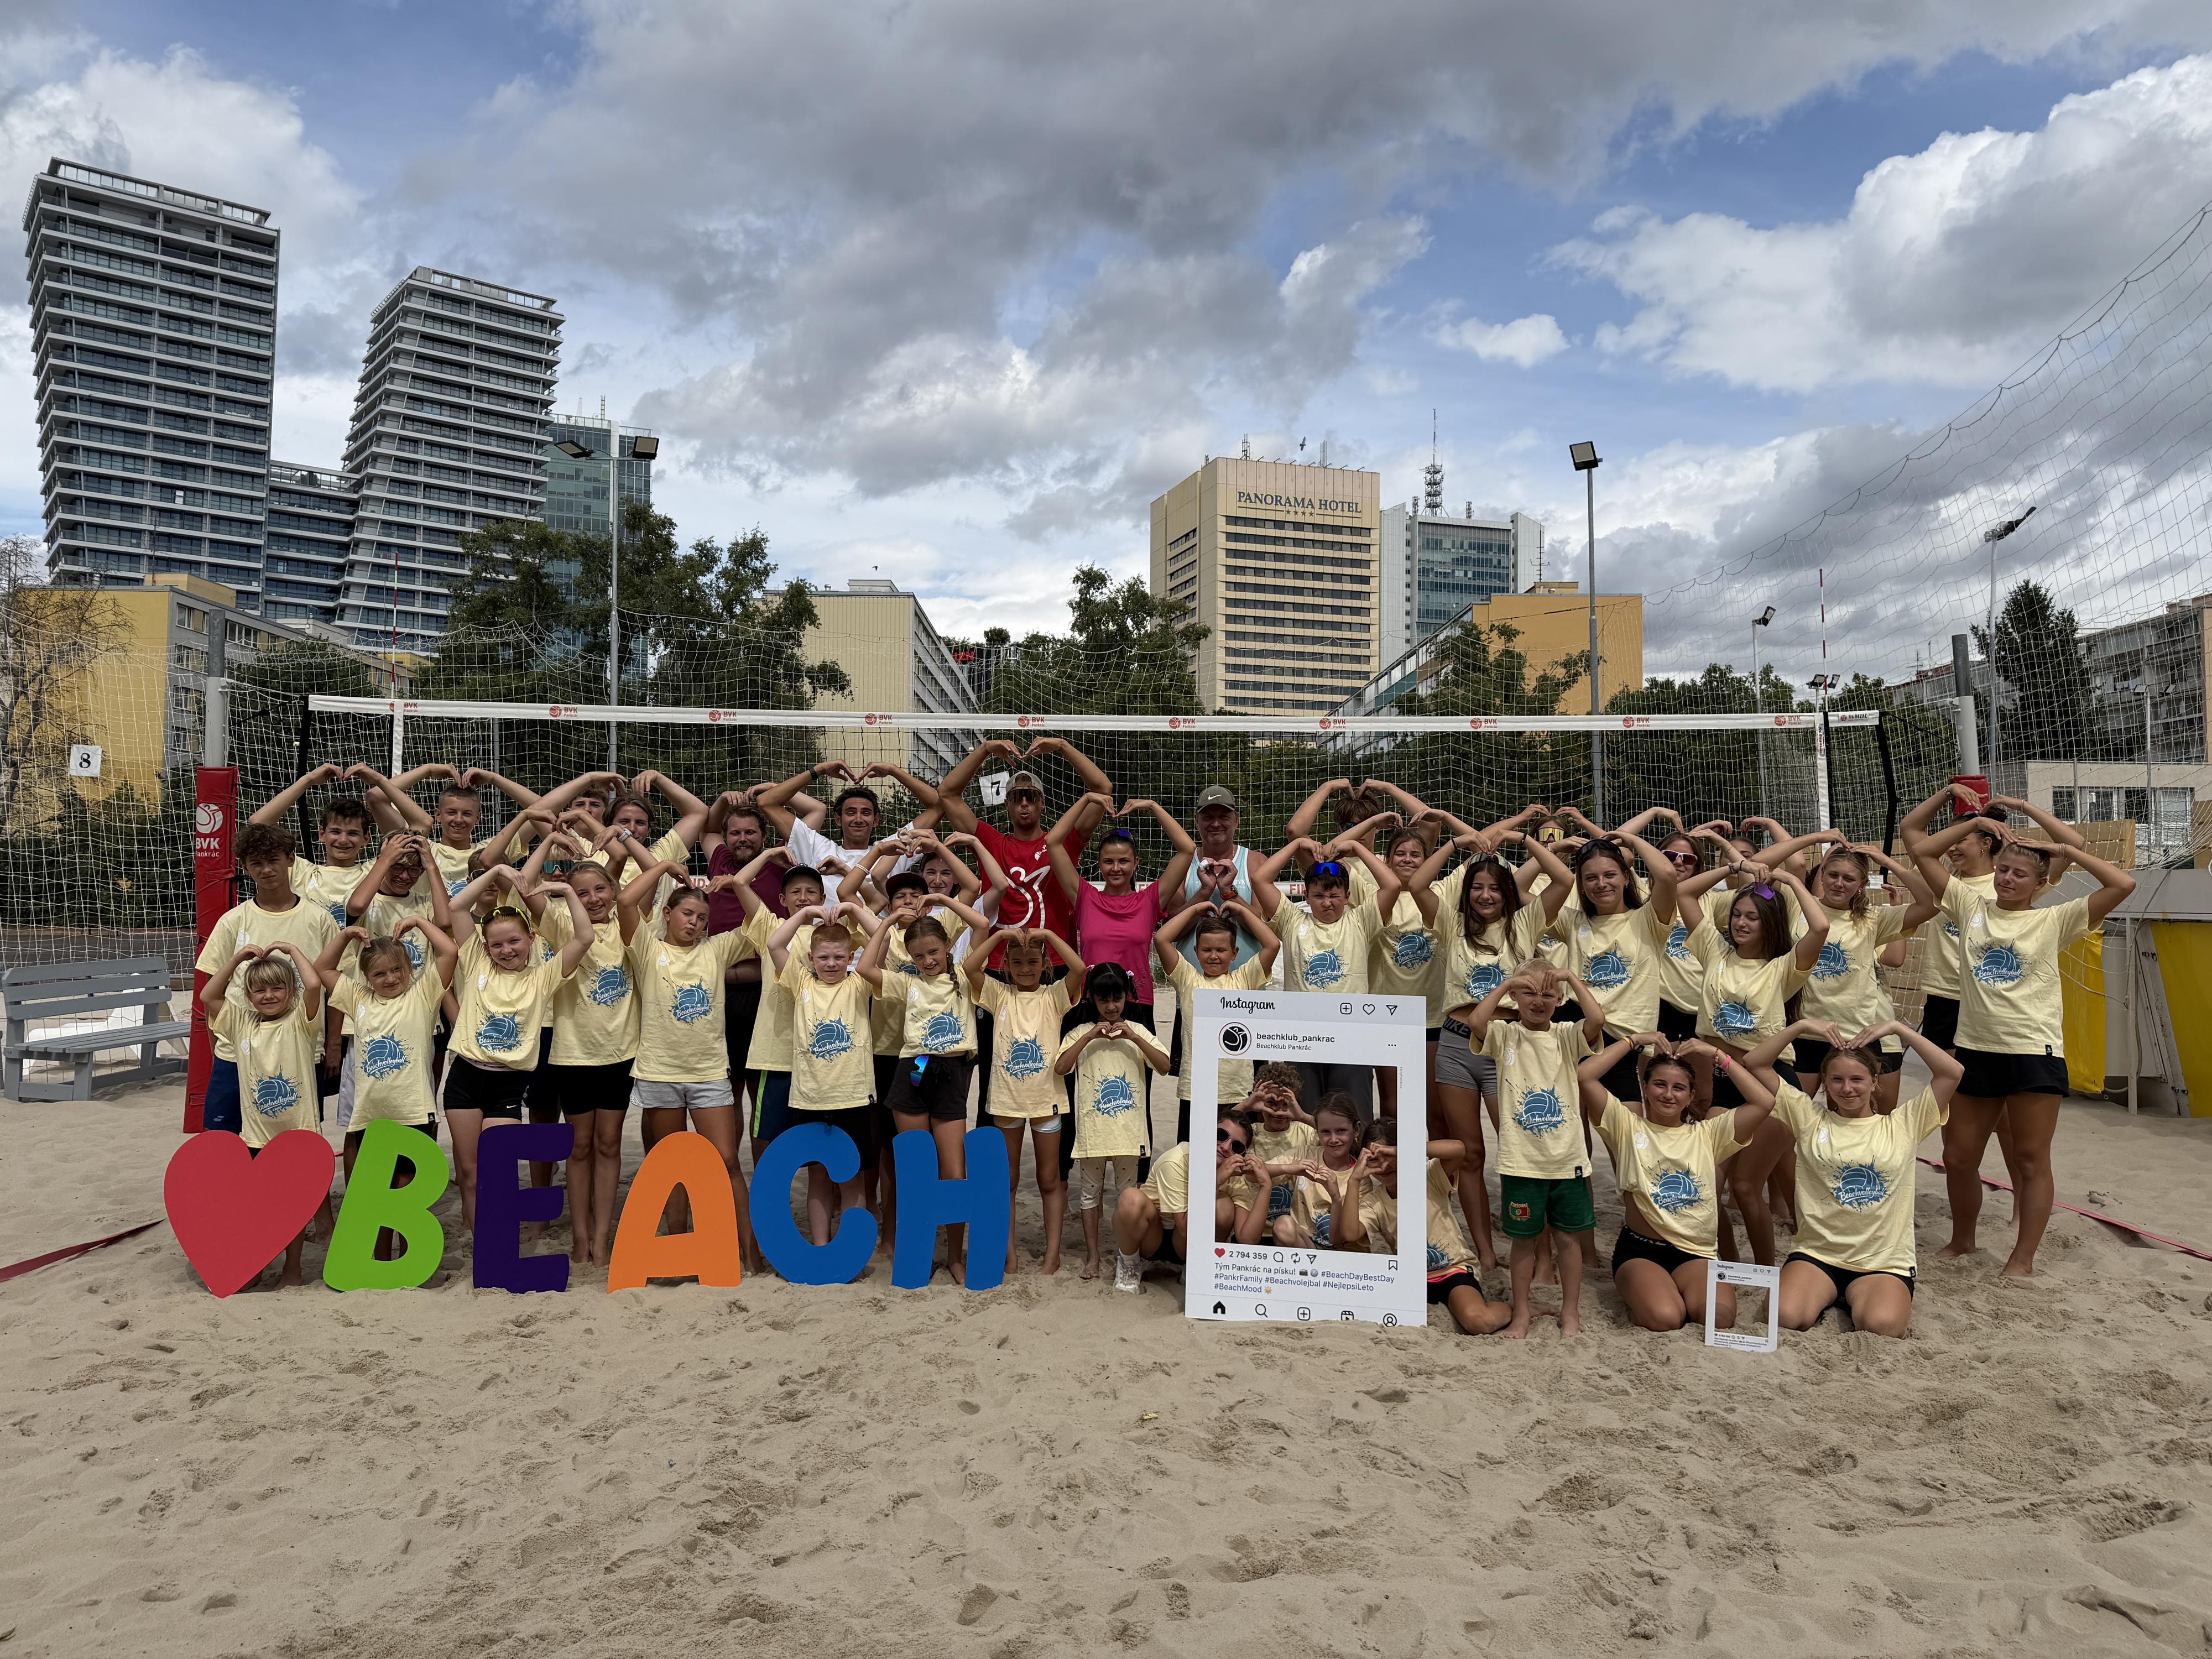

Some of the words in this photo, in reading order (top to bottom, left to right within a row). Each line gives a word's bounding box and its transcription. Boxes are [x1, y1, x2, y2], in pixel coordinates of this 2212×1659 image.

[1238, 491, 1315, 509] PANORAMA
[1318, 499, 1361, 513] HOTEL
[79, 753, 91, 768] 8
[991, 780, 1001, 796] 7
[196, 837, 220, 849] BVK
[1308, 969, 1343, 982] Beachvolleyball
[1978, 968, 2022, 978] Beachvolleyball
[676, 1003, 711, 1018] Beachvolleyball
[1220, 997, 1276, 1014] Instagram
[478, 1036, 520, 1047] Beachvolleyball
[927, 1032, 963, 1048] Beachvolleyball
[1256, 1032, 1335, 1042] beachklub_pankrac
[813, 1040, 852, 1055] Beachvolleyball
[366, 1057, 406, 1073] Beachvolleyball
[1009, 1060, 1044, 1073] Beachvolleyball
[258, 1094, 298, 1111] Beachvolleyball
[1099, 1097, 1134, 1112] Beachvolleyball
[1521, 1114, 1564, 1126] Beachvolleyball
[1839, 1187, 1885, 1201] Beachvolleyball
[323, 1118, 1011, 1295] BEACH
[1214, 1262, 1230, 1271] Tým
[1232, 1264, 1261, 1272] Pankrác
[1321, 1270, 1395, 1284] #BeachDayBestDay
[1214, 1273, 1262, 1284] #PankrFamily
[1265, 1277, 1321, 1288] #Beachvolejbal
[1323, 1281, 1374, 1291] #NejlepsiLeto
[1214, 1283, 1262, 1293] #BeachMood
